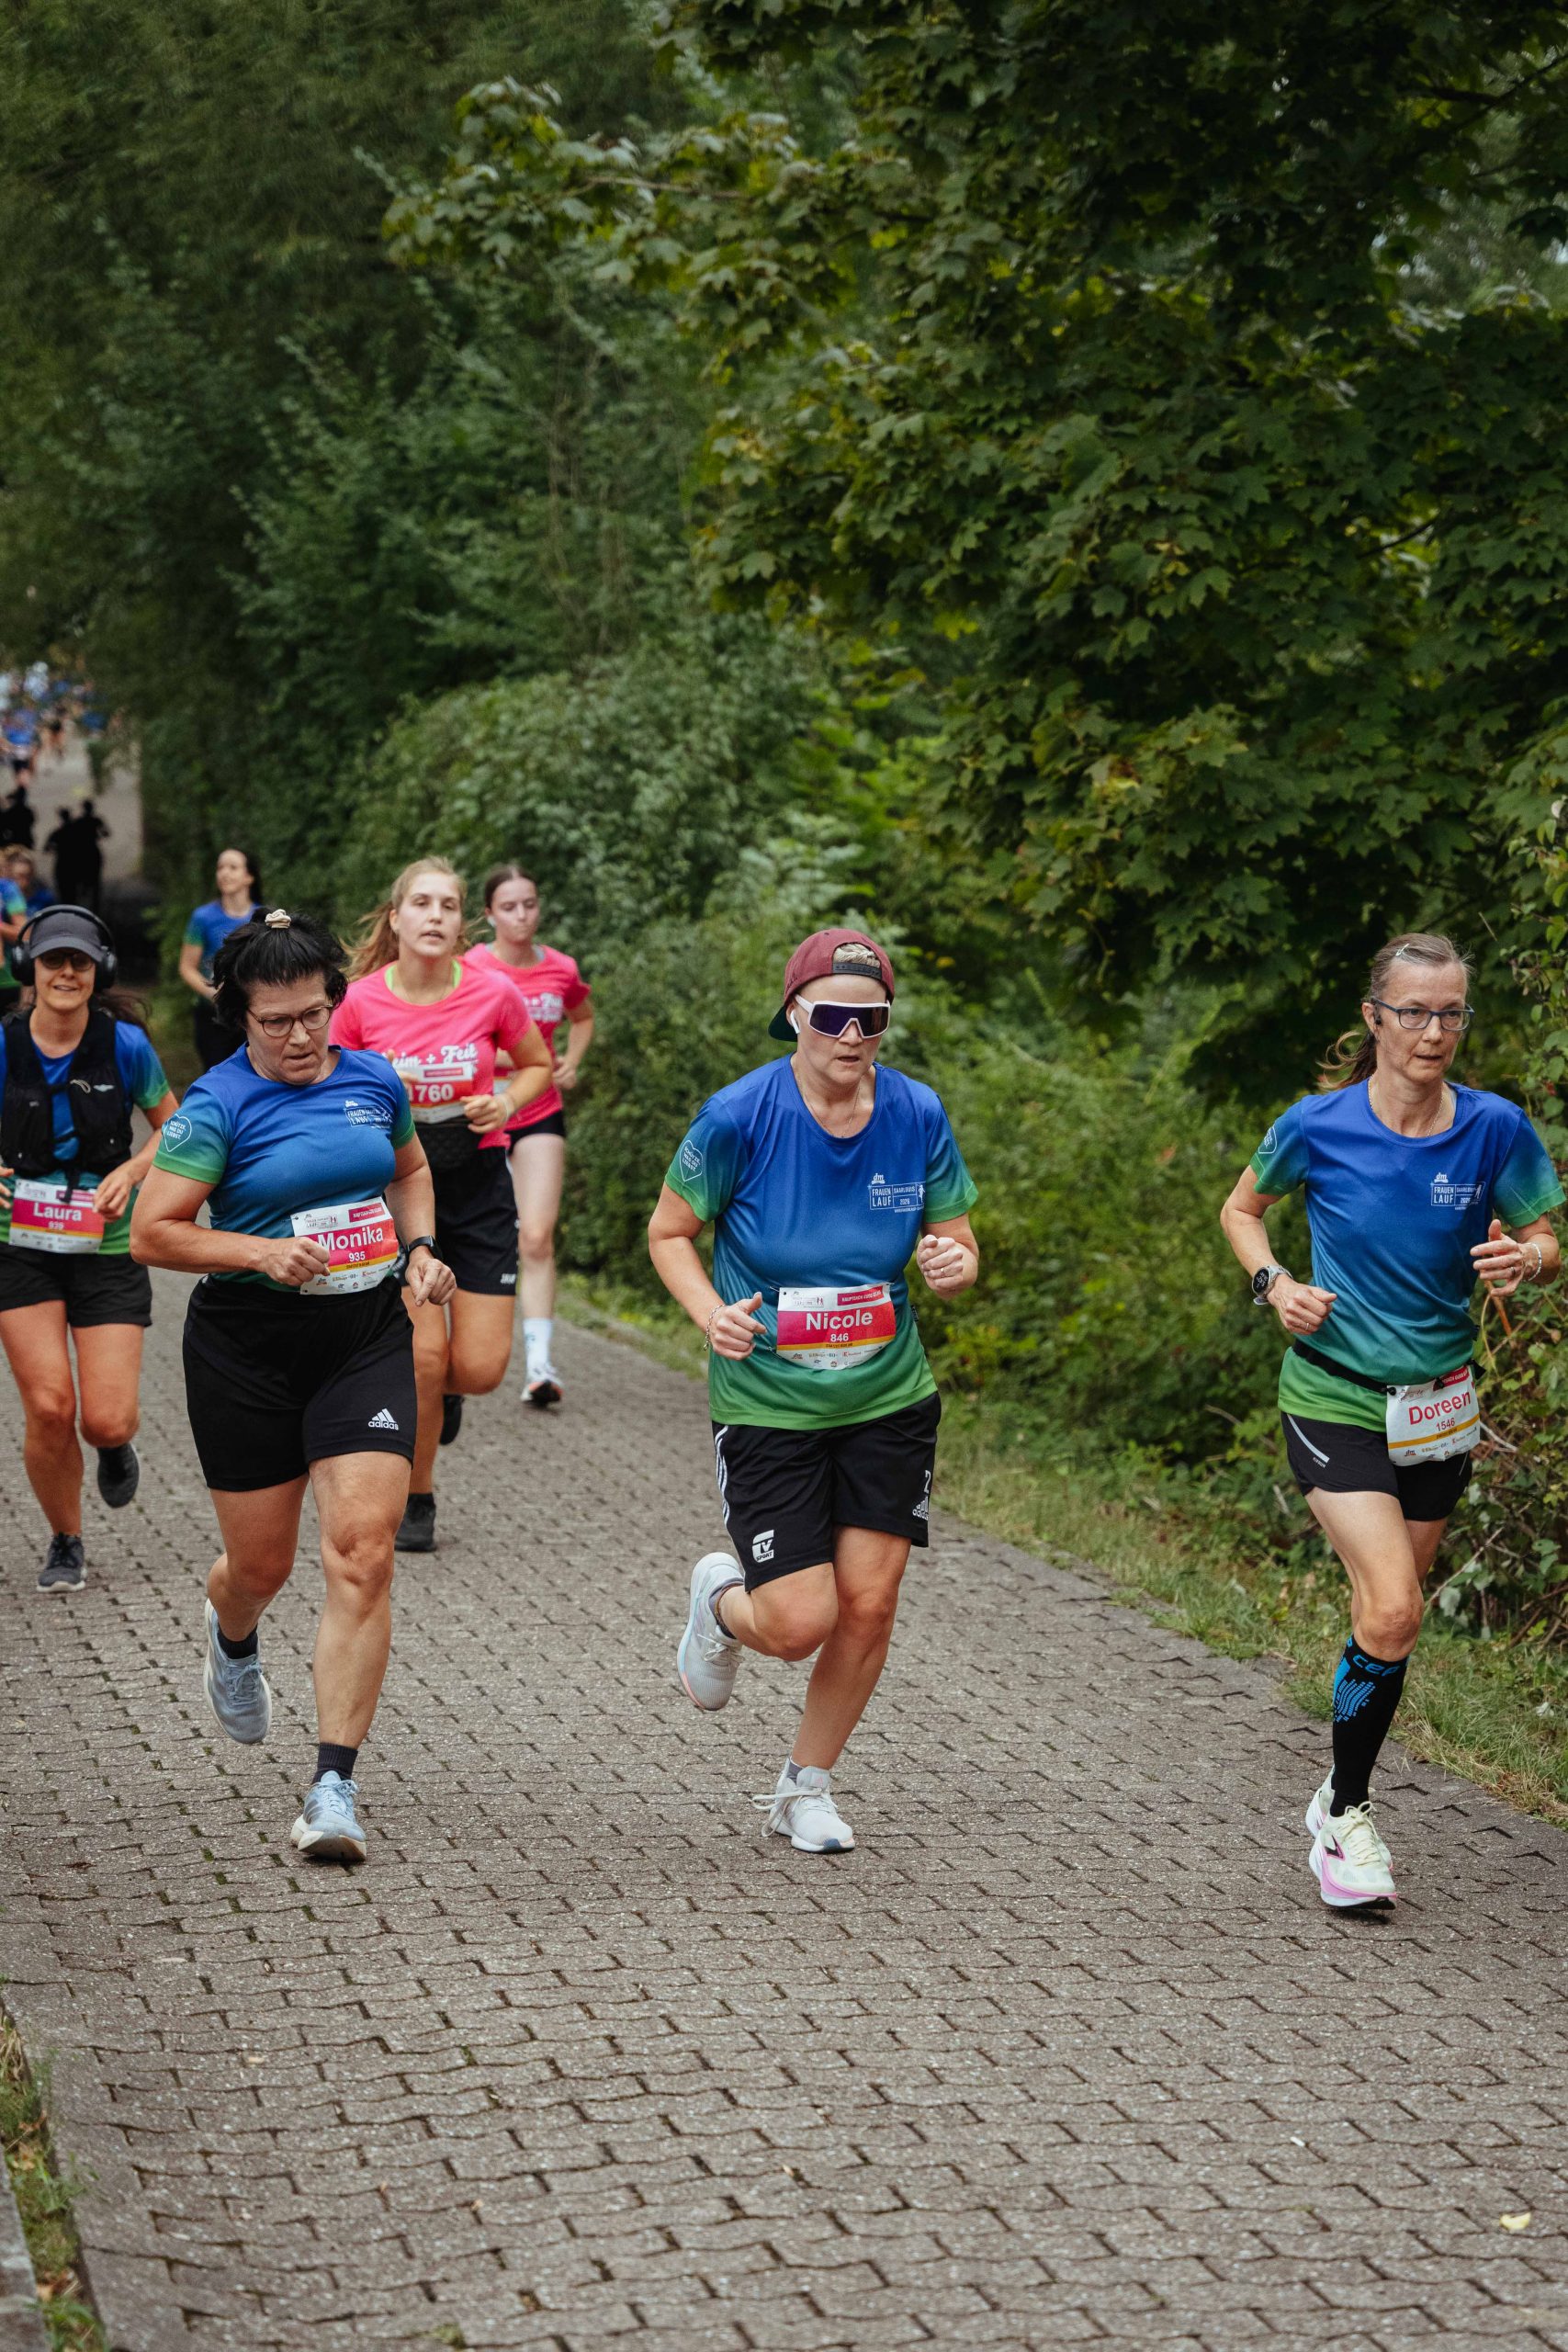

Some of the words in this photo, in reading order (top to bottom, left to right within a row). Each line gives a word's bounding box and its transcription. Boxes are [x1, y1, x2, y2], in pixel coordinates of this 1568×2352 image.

[872, 1187, 892, 1196] FRAUEN
[1434, 1186, 1454, 1194] FRAUEN
[872, 1195, 892, 1207] LAUF
[1433, 1194, 1454, 1204] LAUF
[33, 1202, 82, 1222] Laura
[317, 1227, 384, 1251] Monika
[348, 1250, 366, 1262] 935
[806, 1309, 874, 1330] Nicole
[829, 1333, 849, 1342] 846
[1408, 1391, 1472, 1425] Doreen
[367, 1420, 400, 1431] adidas
[1436, 1418, 1456, 1431] 1546
[756, 1551, 773, 1561] SPORT
